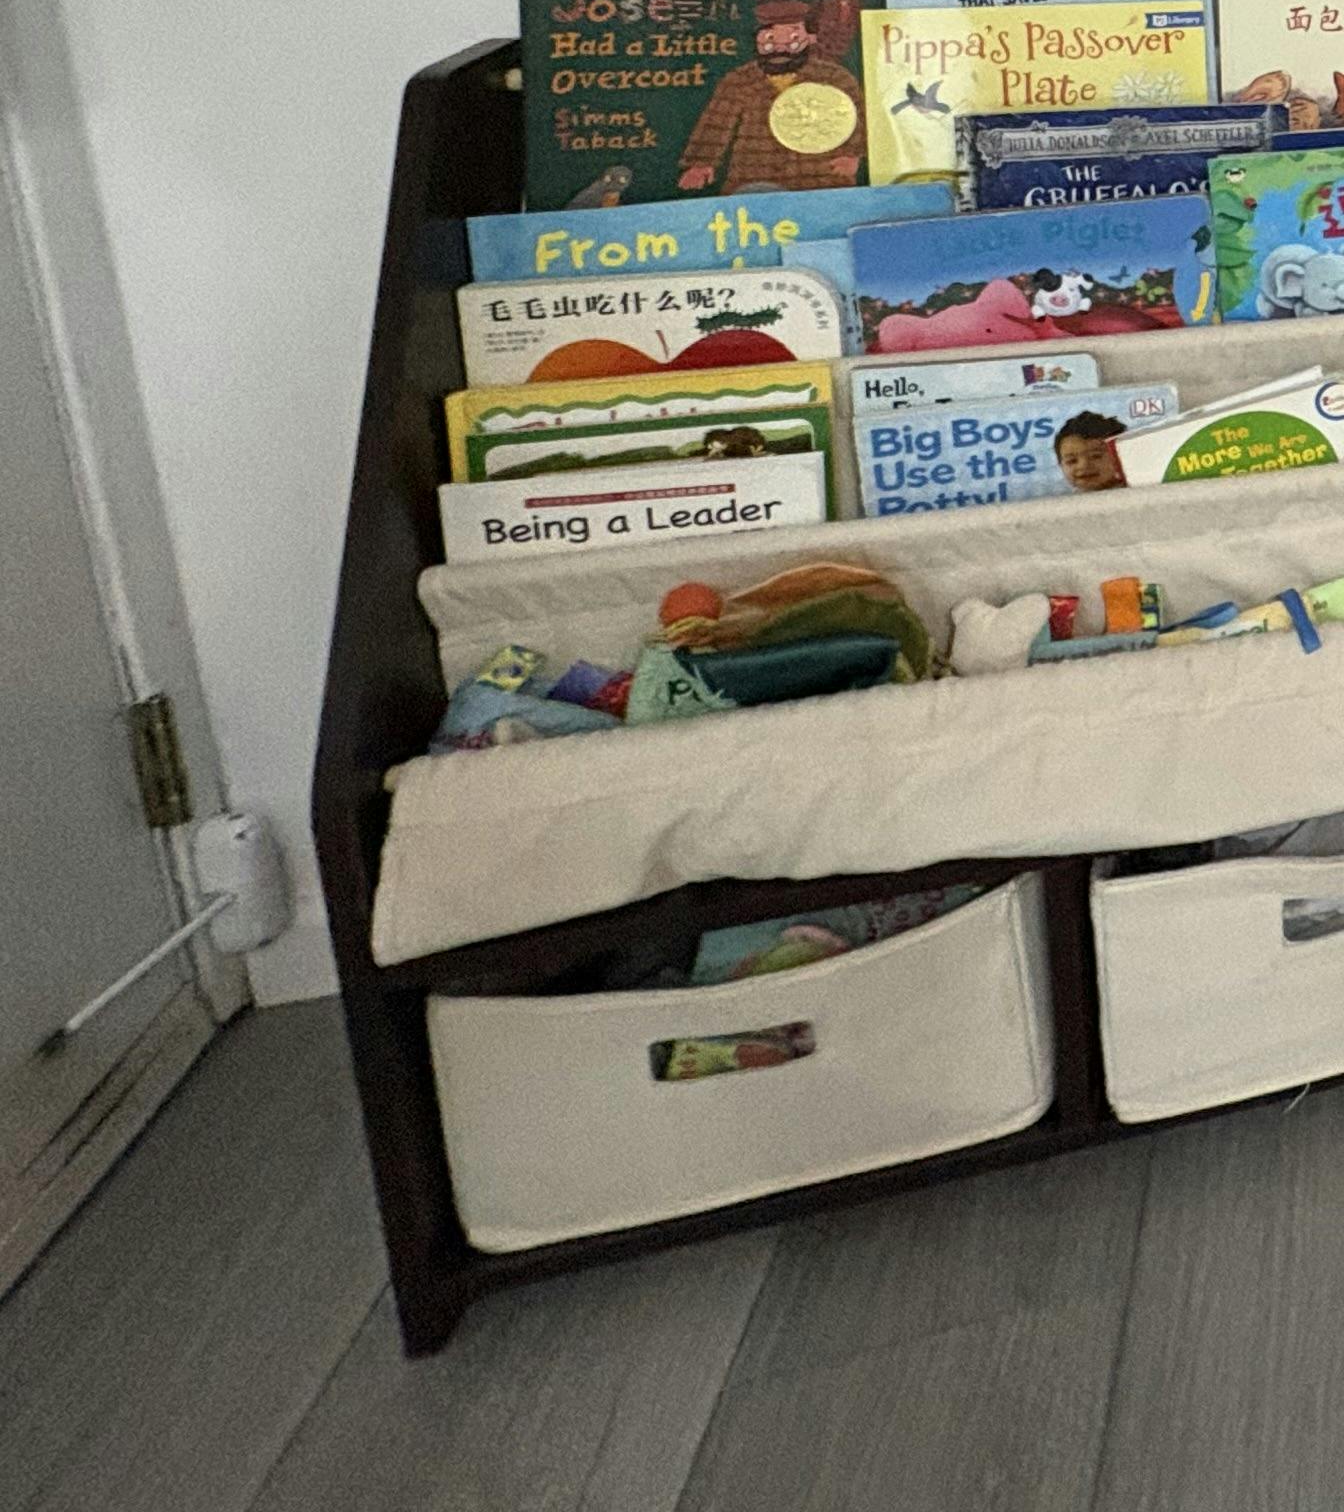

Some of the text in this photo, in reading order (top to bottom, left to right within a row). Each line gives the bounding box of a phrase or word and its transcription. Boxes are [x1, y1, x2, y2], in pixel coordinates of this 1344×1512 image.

[550, 31, 738, 59] Had a Little
[881, 21, 1186, 76] Pippa's Passover
[550, 62, 709, 94] Overcoat
[1000, 67, 1097, 108] Plate
[554, 103, 647, 130] Simms
[556, 128, 658, 151] Taback
[1061, 164, 1102, 182] THE
[534, 206, 800, 274] From the
[864, 375, 925, 400] Hello,
[1129, 398, 1165, 419] DK
[869, 414, 1056, 461] Big Boys
[1211, 424, 1250, 443] The
[873, 450, 1036, 492] Use the
[1176, 445, 1242, 476] More
[481, 498, 783, 545] Being a Leader
